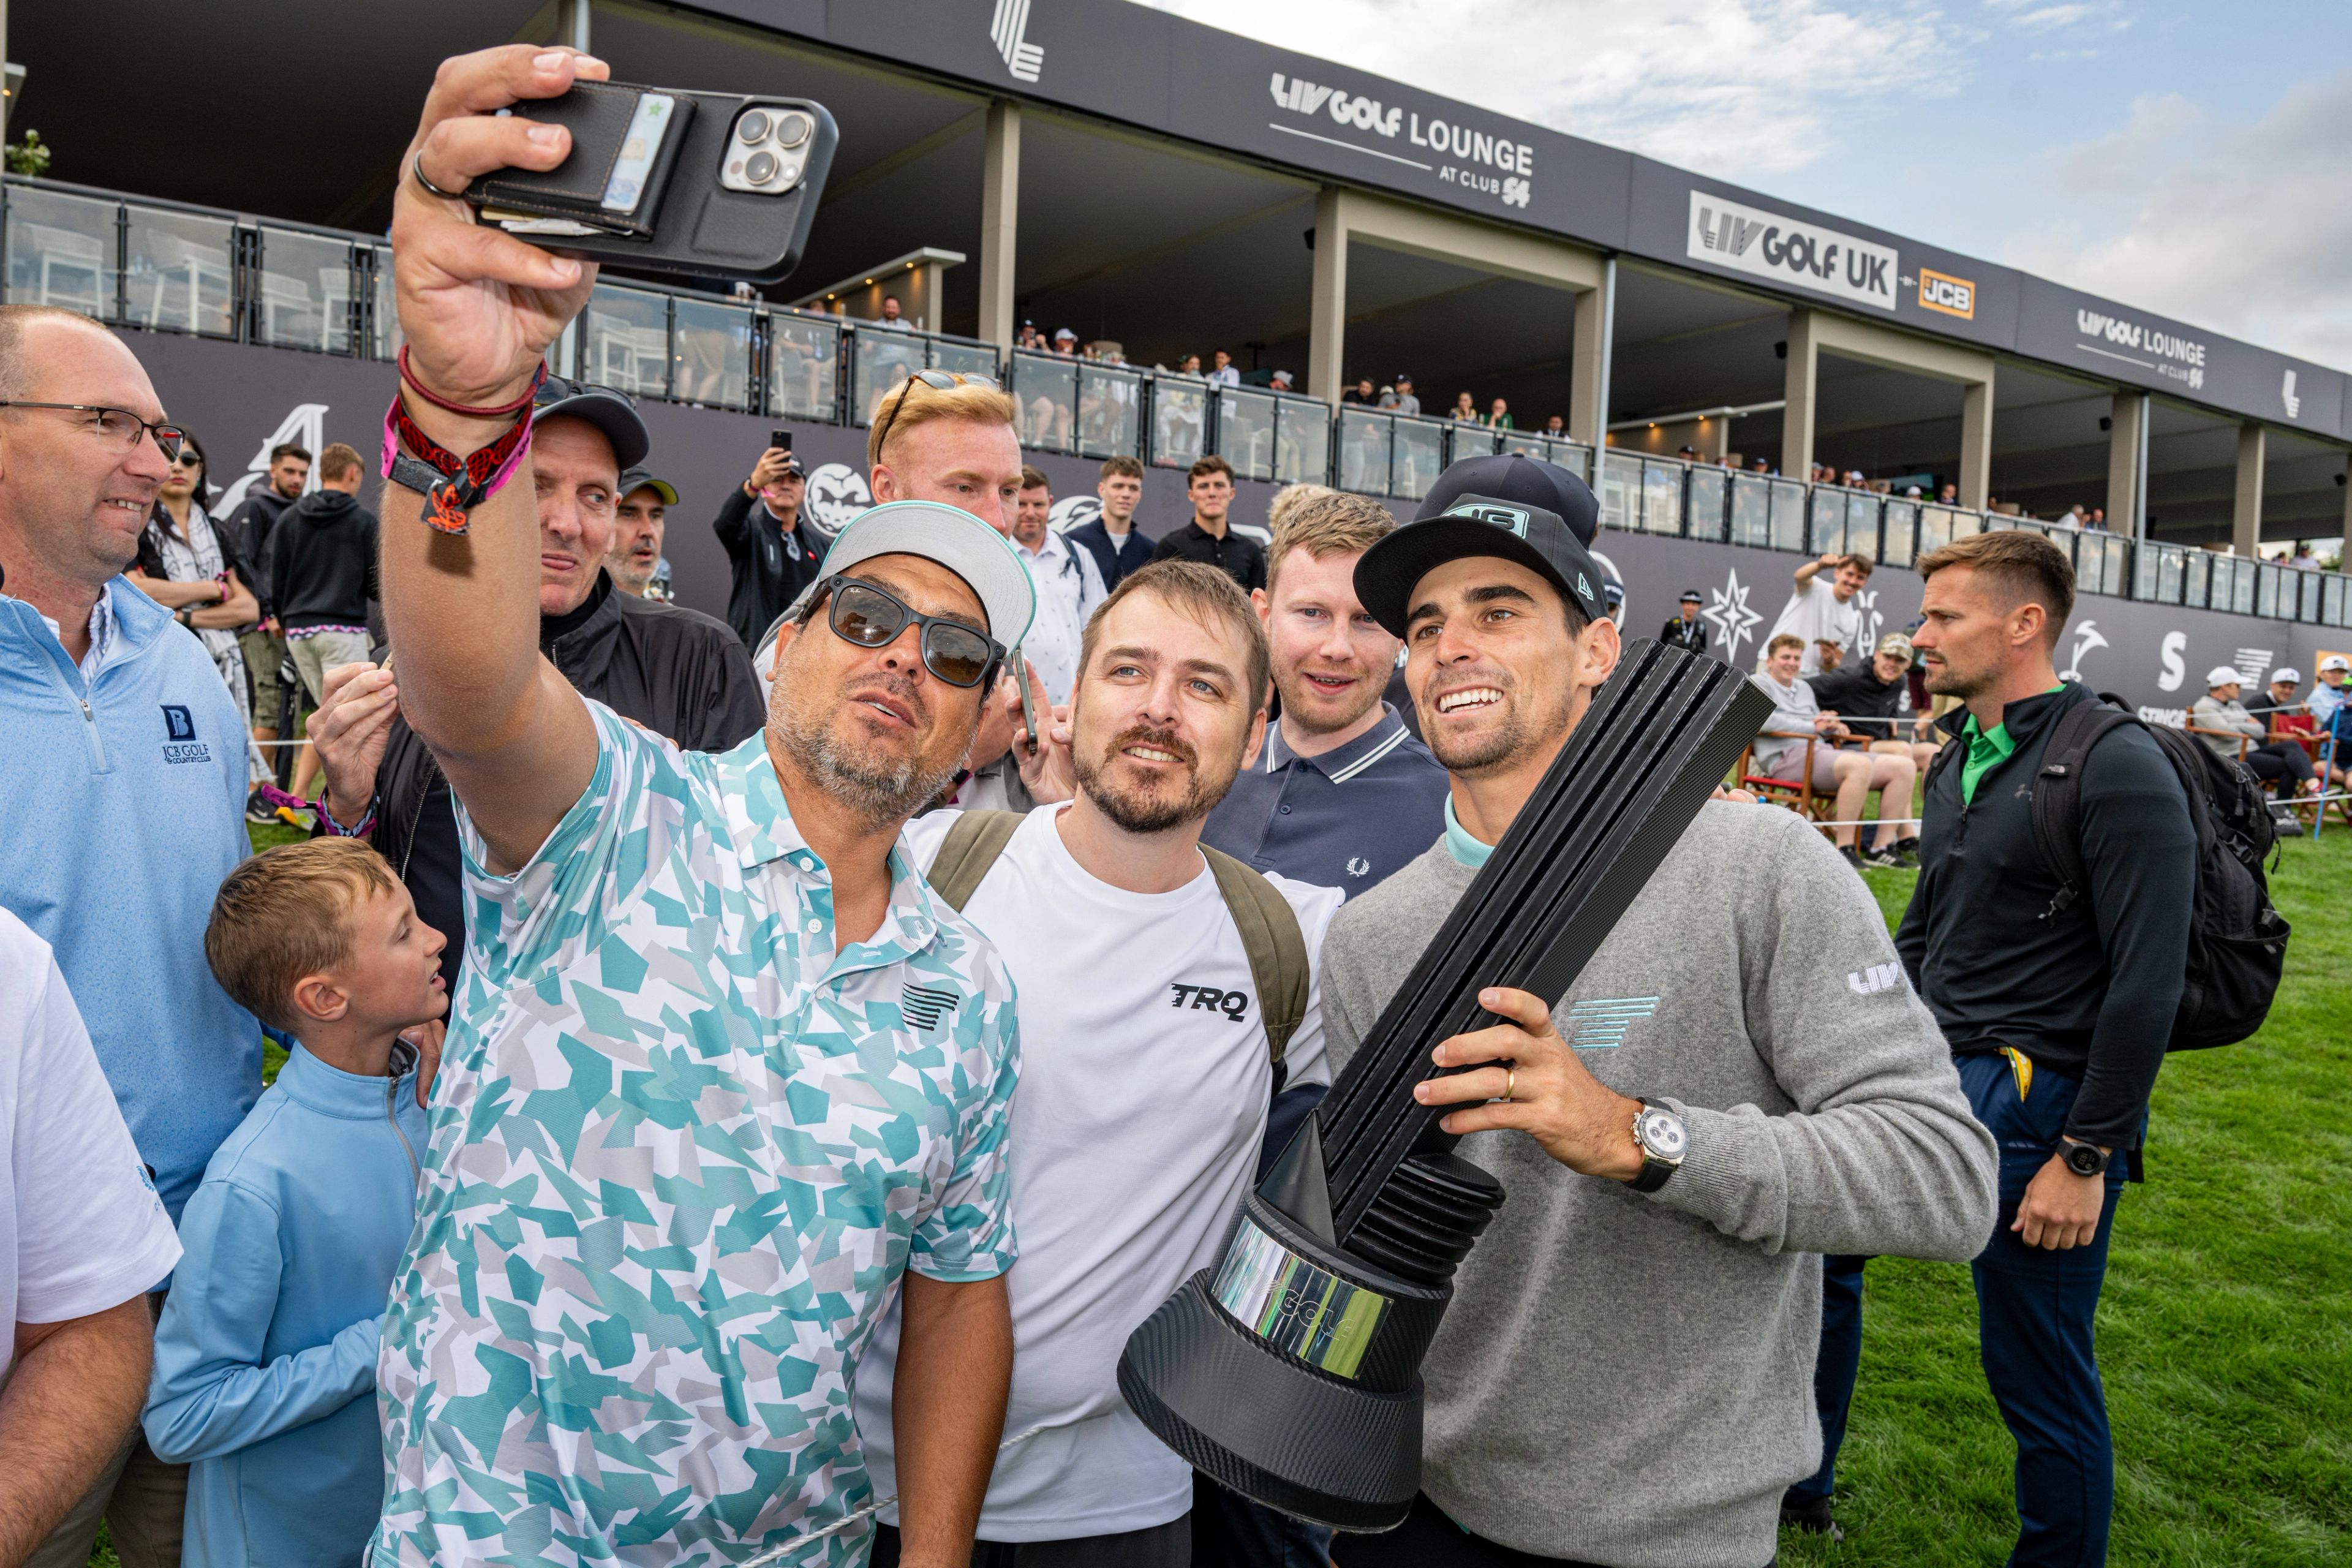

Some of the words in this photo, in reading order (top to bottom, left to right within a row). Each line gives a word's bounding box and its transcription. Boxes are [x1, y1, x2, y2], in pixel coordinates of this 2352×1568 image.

[1409, 113, 1533, 176] LOUNGE
[1439, 165, 1458, 183] AT
[1460, 170, 1500, 195] CLUB
[1501, 176, 1531, 209] 54
[1847, 248, 1890, 296] UK
[1924, 279, 1970, 311] JCB
[2144, 329, 2205, 367] LOUNGE
[2138, 706, 2187, 729] STINGE
[162, 745, 181, 761] JCB
[181, 743, 209, 757] GOLF
[1848, 962, 1899, 994] LIV
[1171, 982, 1248, 1023] TRQ
